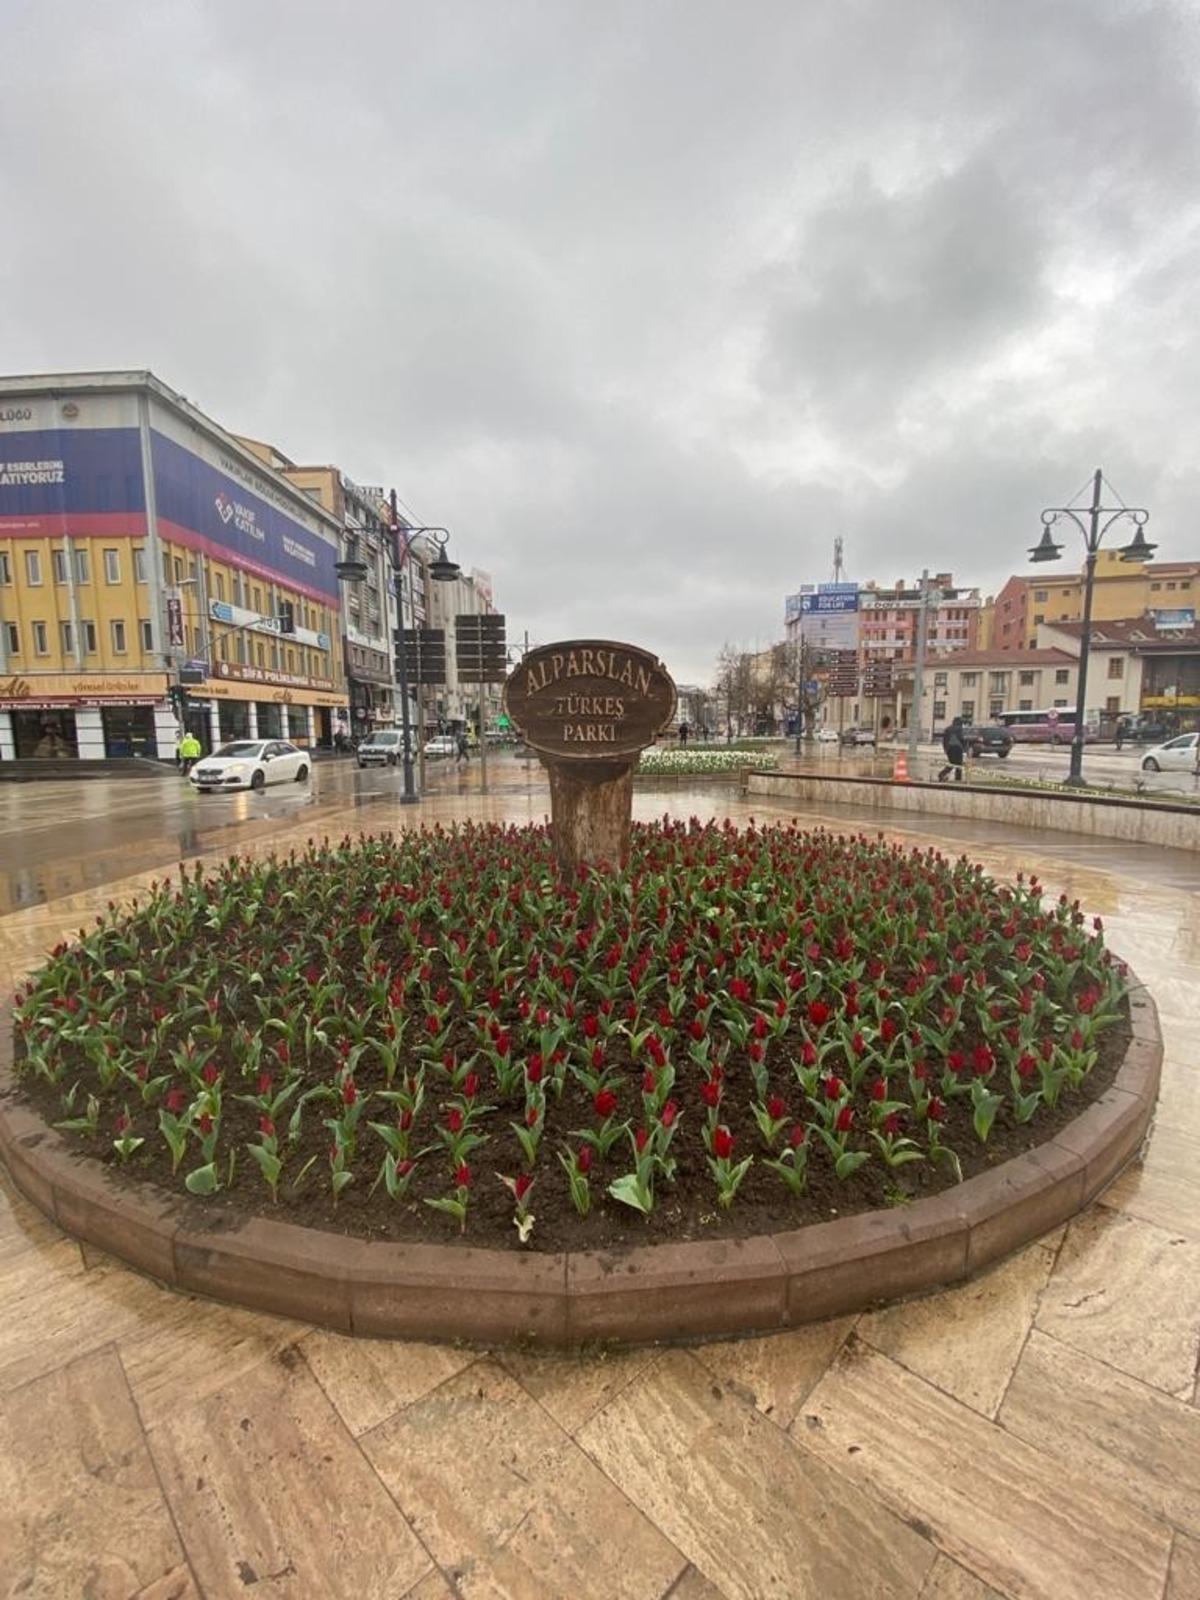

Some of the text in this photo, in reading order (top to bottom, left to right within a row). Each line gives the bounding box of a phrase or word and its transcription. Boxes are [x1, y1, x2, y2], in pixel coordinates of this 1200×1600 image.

[526, 649, 652, 697] ALPARSLAN
[556, 693, 624, 720] TÜRKEŞ
[563, 724, 617, 742] PARKI
